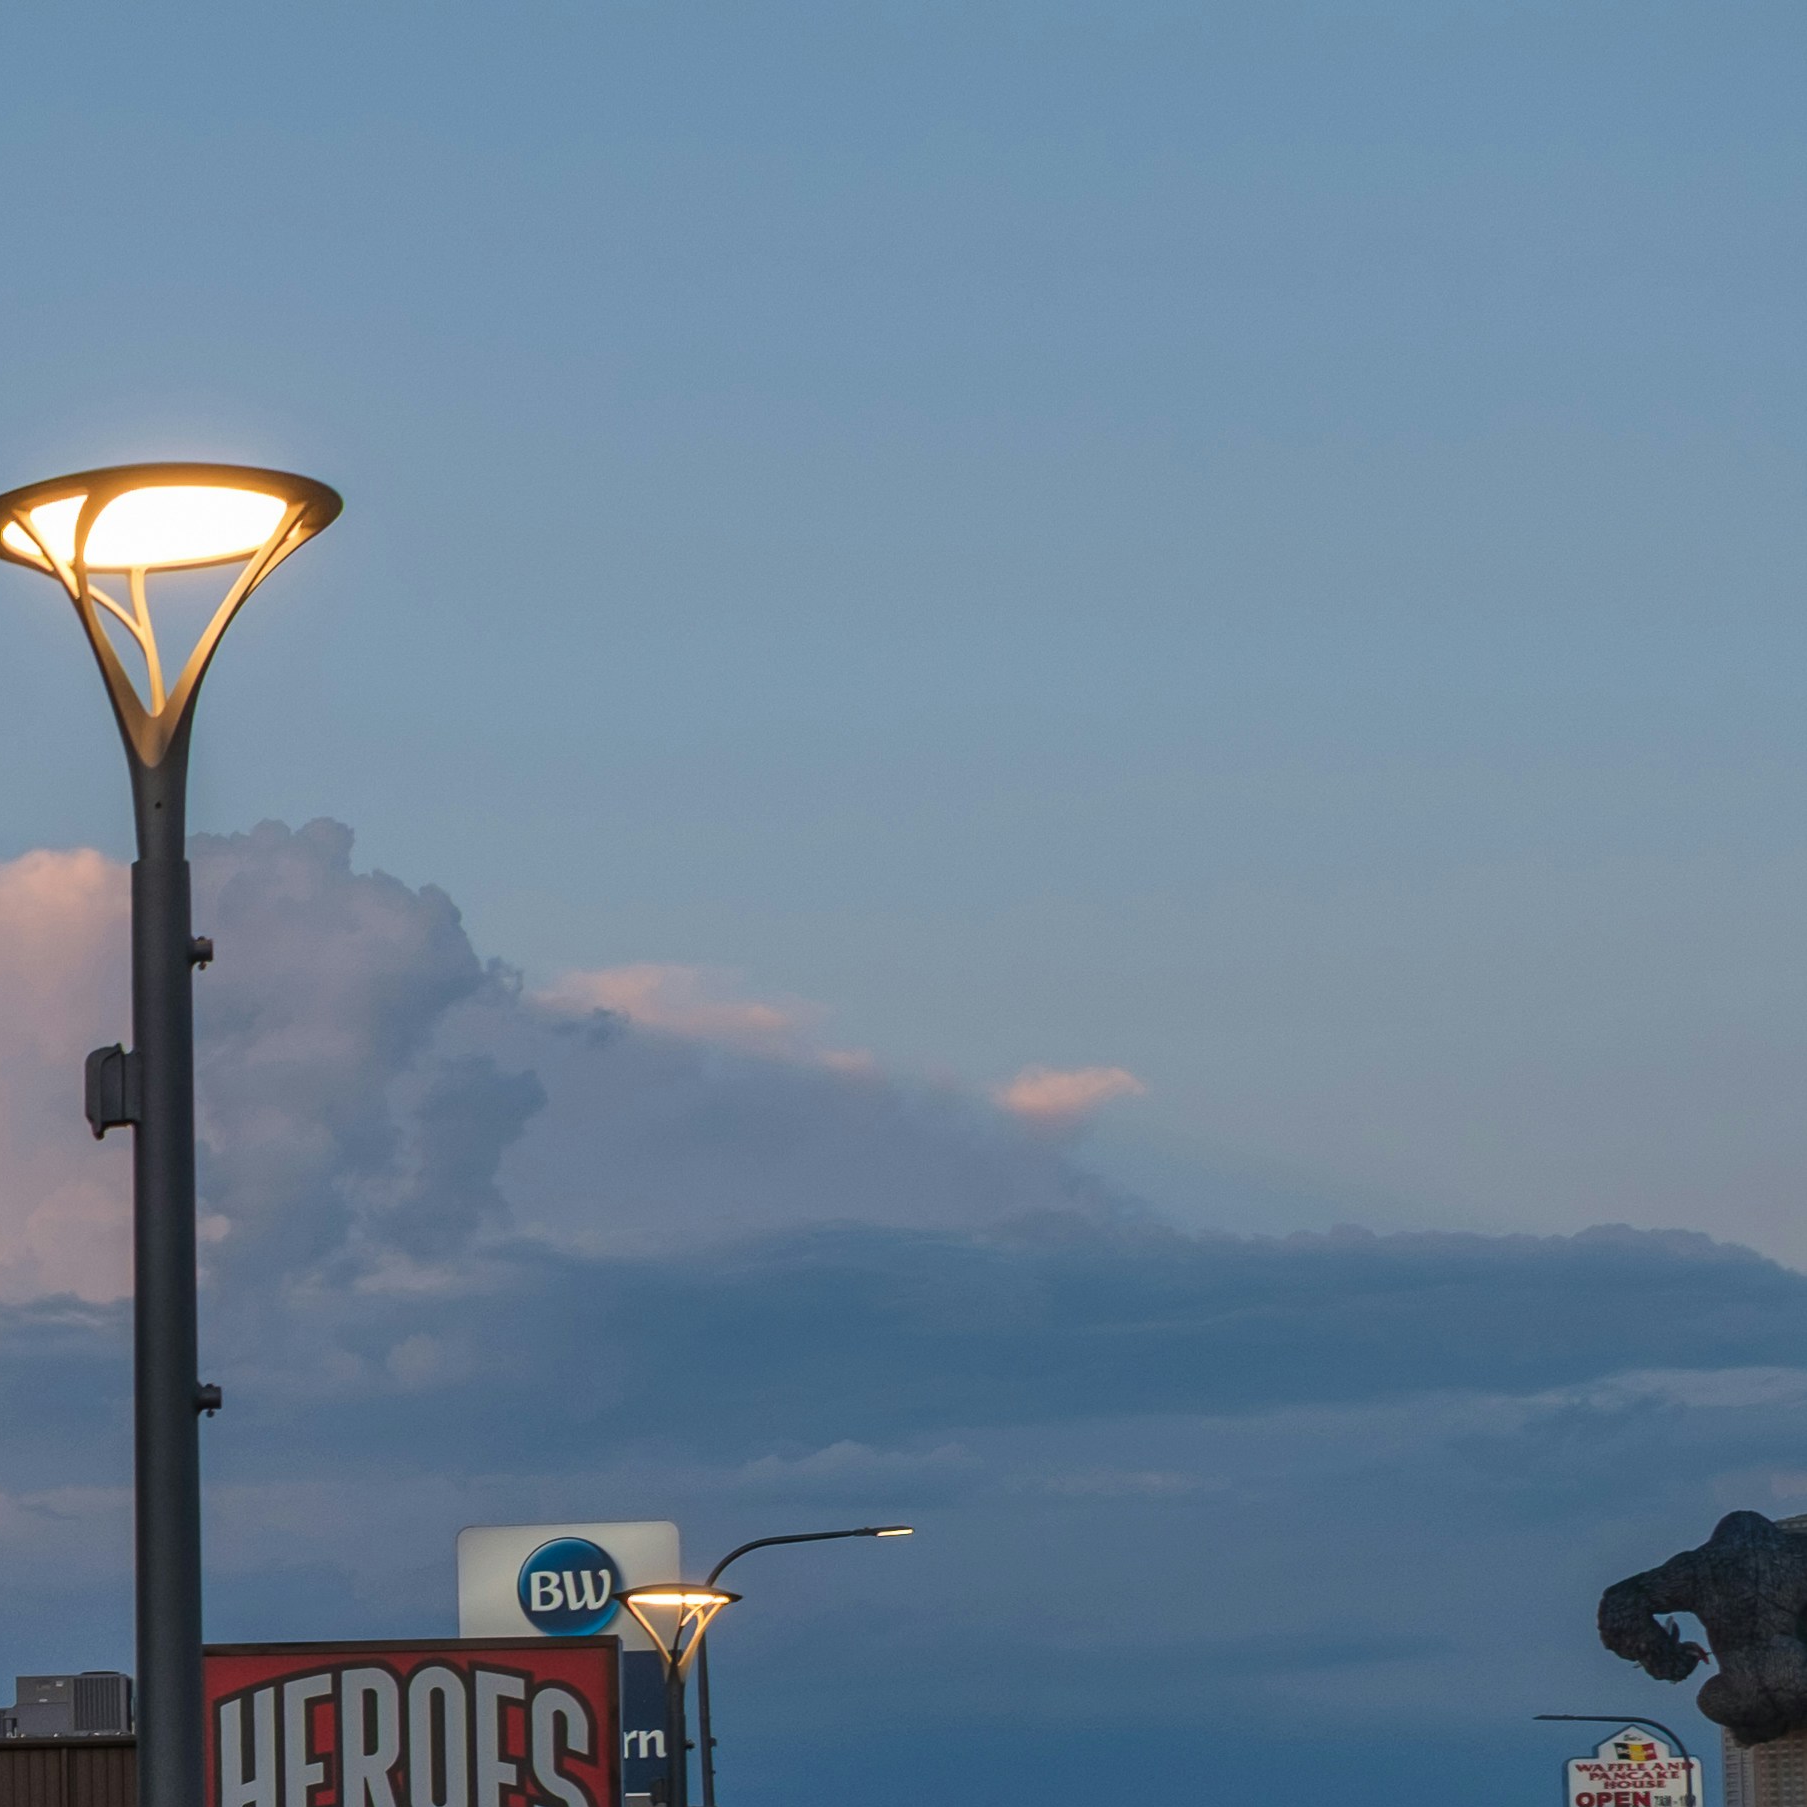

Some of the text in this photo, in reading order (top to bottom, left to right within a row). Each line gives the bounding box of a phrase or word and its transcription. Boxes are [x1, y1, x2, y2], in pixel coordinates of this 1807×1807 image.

[530, 1569, 611, 1611] BW
[1575, 1763, 1646, 1772] WAFFLE
[1589, 1771, 1680, 1780] PANCAKE
[1604, 1780, 1667, 1789] HOUSE
